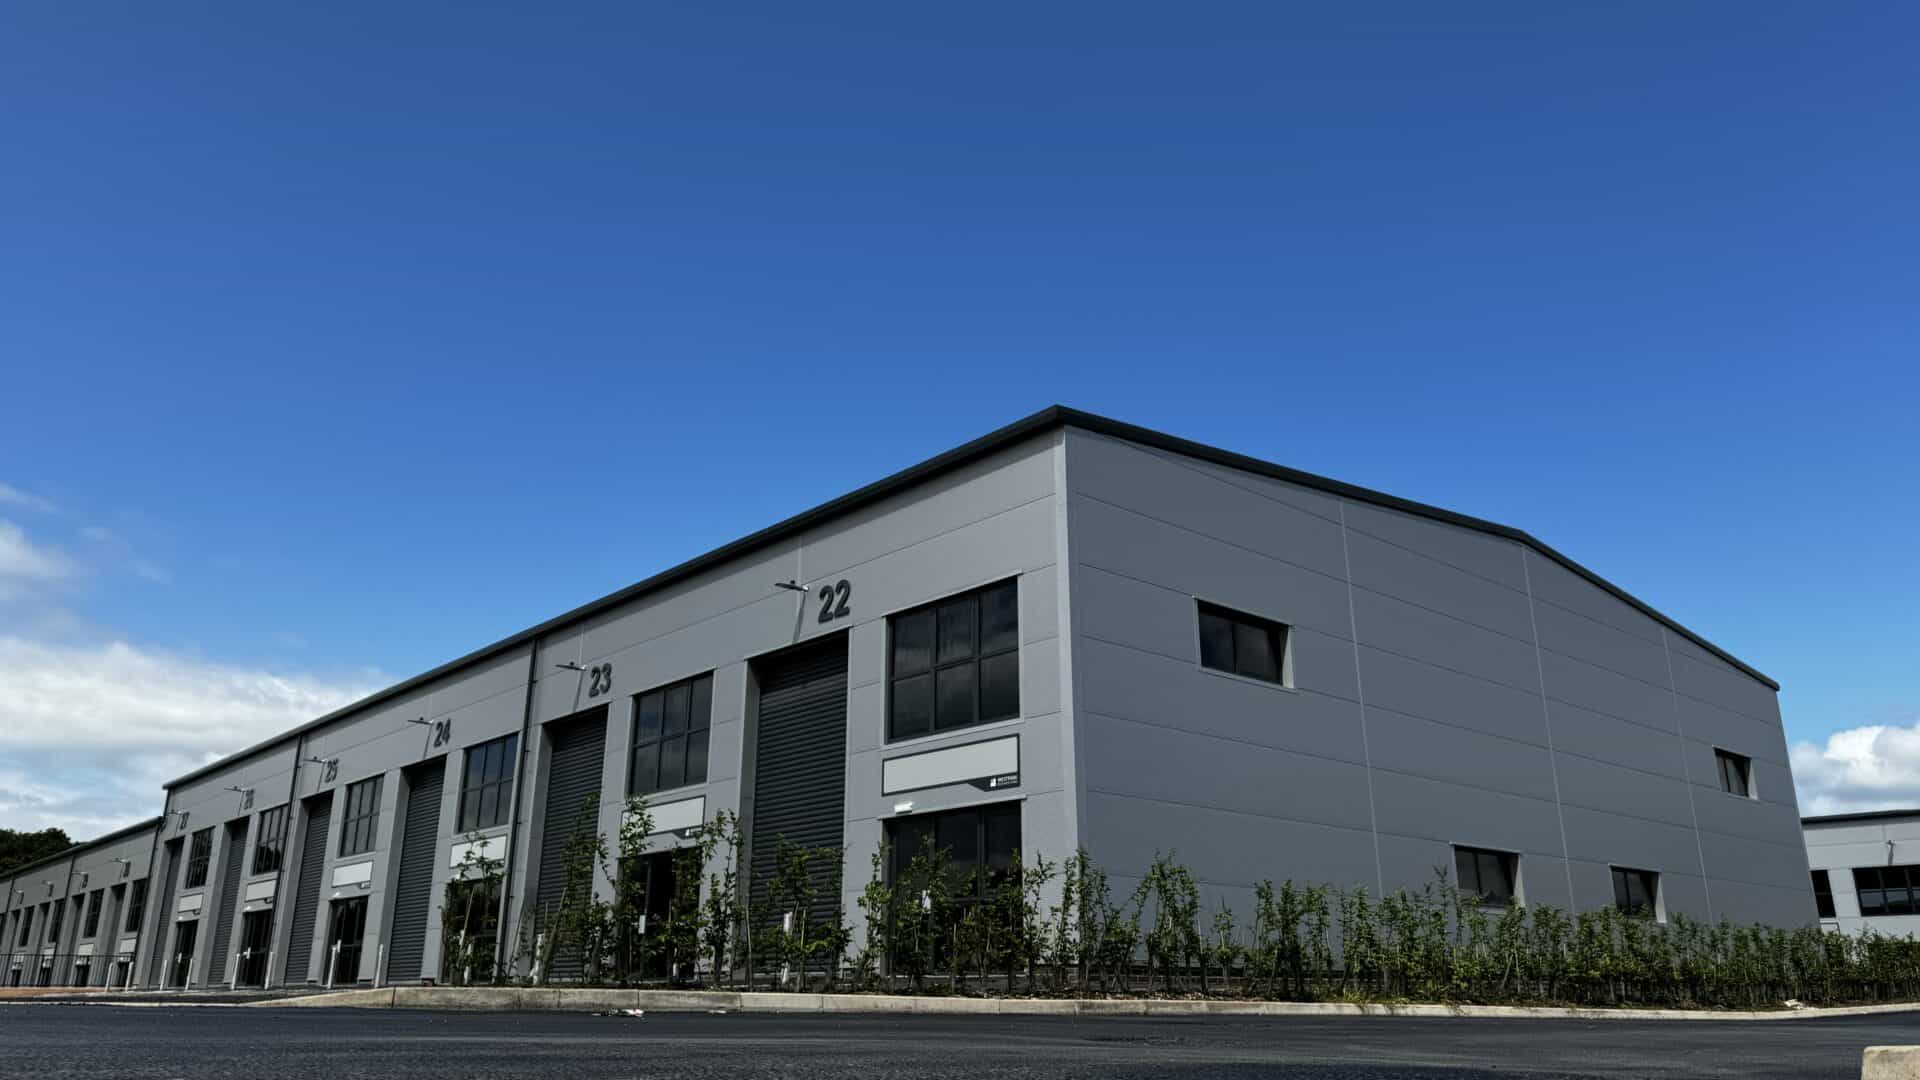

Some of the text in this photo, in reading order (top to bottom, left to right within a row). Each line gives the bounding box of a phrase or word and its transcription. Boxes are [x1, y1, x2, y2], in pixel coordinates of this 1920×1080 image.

[818, 579, 851, 624] 22
[589, 663, 612, 698] 23
[434, 718, 451, 748] 24
